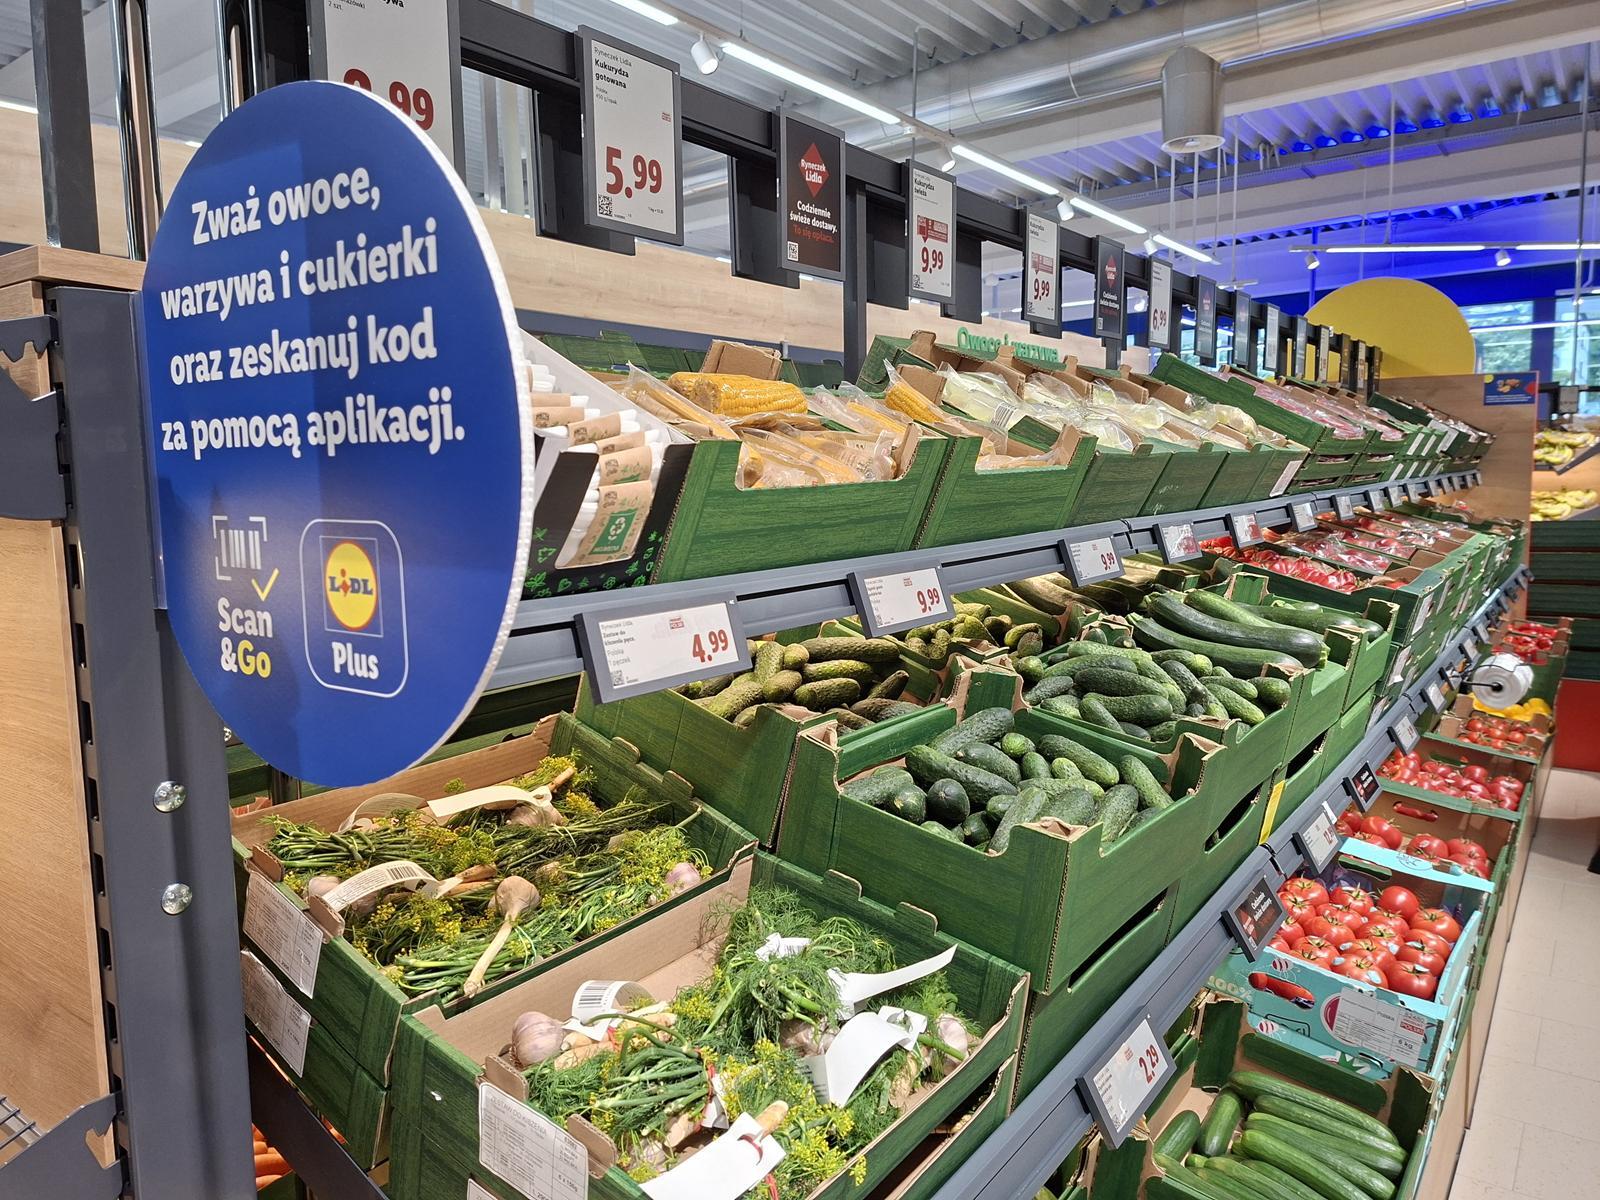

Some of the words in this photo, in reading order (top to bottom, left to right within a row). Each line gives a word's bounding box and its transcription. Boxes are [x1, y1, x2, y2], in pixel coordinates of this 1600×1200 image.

[595, 58, 629, 78] Kukurydza
[595, 73, 627, 89] gotowana
[606, 146, 662, 199] 5.99
[800, 158, 826, 172] Ryneczek
[805, 171, 823, 184] Lidla
[191, 185, 261, 245] Zważ
[268, 167, 381, 226] owoce,
[789, 211, 811, 225] świeże
[811, 217, 838, 234] dostawy.
[797, 200, 831, 219] Codziennie
[161, 269, 274, 322] warzywa
[280, 250, 291, 299] i
[298, 217, 438, 295] cukierki
[921, 246, 944, 274] 9.99
[1033, 278, 1050, 301] 9.99
[170, 350, 224, 385] oraz
[229, 315, 359, 380] zeskanuj
[367, 306, 438, 364] kod
[957, 326, 1000, 352] Owoce
[1011, 341, 1059, 363] warzywa
[161, 420, 187, 450] za
[193, 413, 301, 460] pomocą
[307, 386, 466, 456] aplikacji.
[1101, 552, 1116, 572] 9.99
[916, 587, 941, 613] 9.99
[217, 597, 274, 638] Scan
[220, 636, 272, 678] &Go
[331, 641, 380, 680] Plus
[692, 629, 729, 663] 4.99
[1139, 1044, 1159, 1084] 2.29
